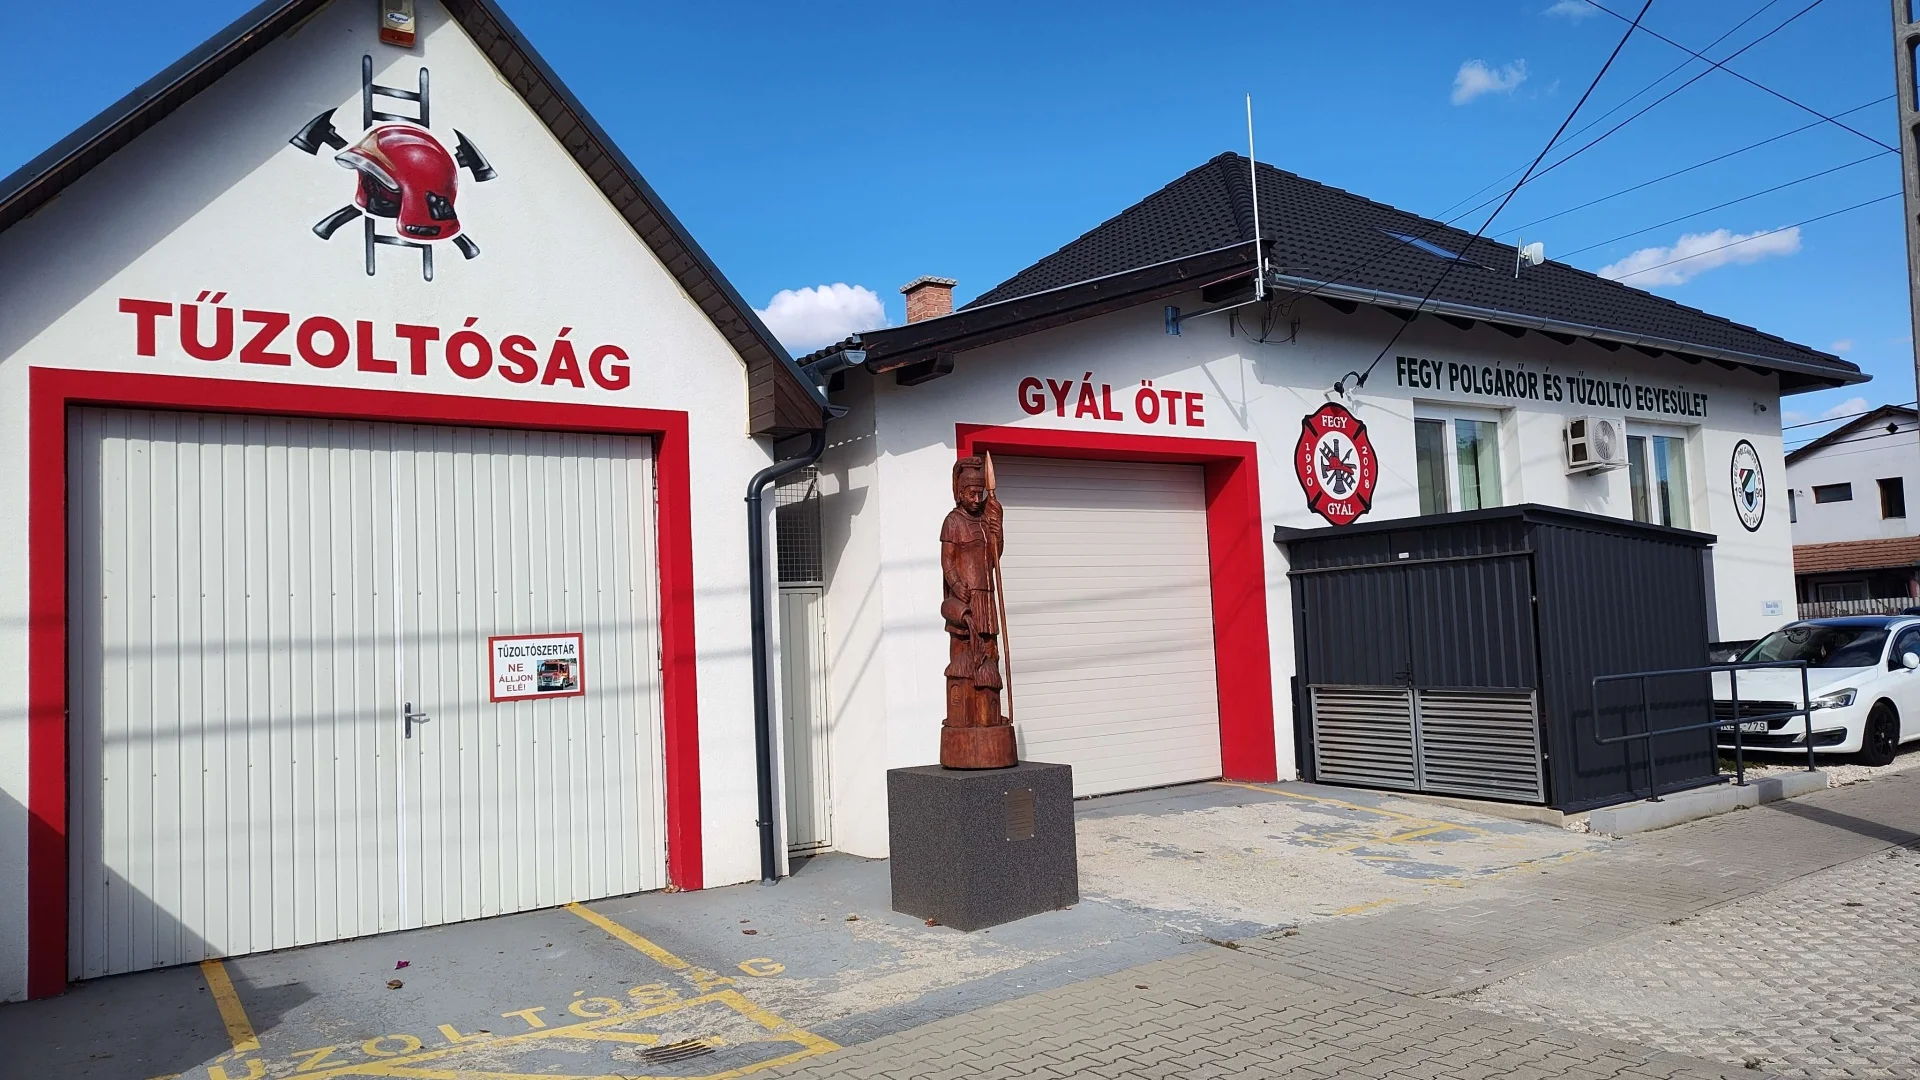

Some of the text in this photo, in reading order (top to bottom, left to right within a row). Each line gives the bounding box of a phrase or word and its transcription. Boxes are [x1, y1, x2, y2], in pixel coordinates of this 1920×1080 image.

[119, 290, 630, 391] TŰZOLTÓSÁG
[1396, 356, 1707, 417] FEGY POLGÁRŐR ÉS TŰZOLTÓ EGYESÜLET
[1018, 371, 1204, 427] GYÁL ÖTE
[1322, 415, 1348, 429] FEGY
[1328, 501, 1354, 516] GYÁL
[498, 641, 575, 658] TŰZOLTÓSZERTÁR
[508, 663, 524, 673] NE
[499, 674, 533, 683] ÁLLJON
[506, 683, 526, 692] ELÉ!
